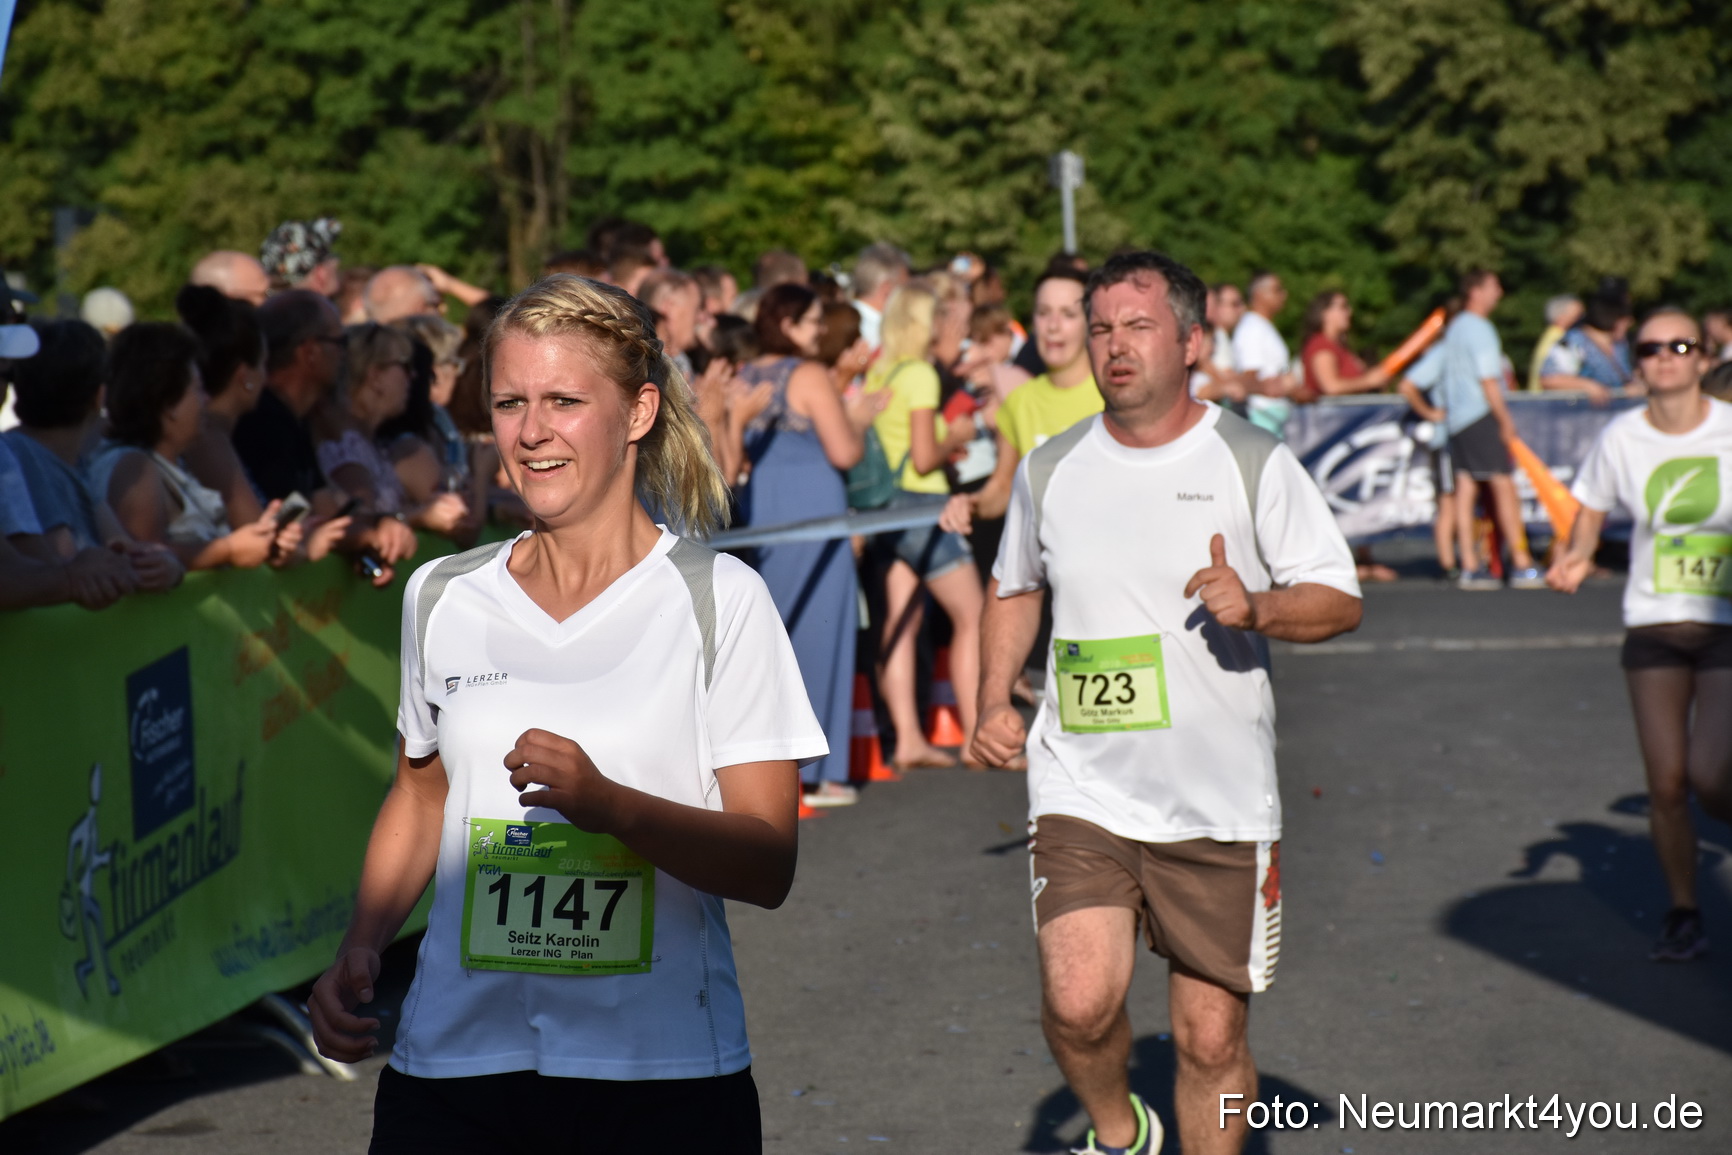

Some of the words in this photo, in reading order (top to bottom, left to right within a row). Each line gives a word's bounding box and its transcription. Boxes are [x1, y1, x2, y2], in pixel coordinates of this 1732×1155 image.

[1177, 492, 1214, 502] Markus
[1676, 557, 1722, 578] 147
[467, 673, 508, 683] LERZER
[1072, 672, 1136, 706] 723
[1101, 707, 1134, 717] Markus
[492, 842, 554, 858] firmenlauf
[558, 858, 592, 870] 2018
[487, 873, 629, 931] 1147
[507, 931, 541, 945] Seitz
[546, 933, 600, 948] Karolin
[510, 946, 541, 957] Lerzer
[543, 949, 562, 959] ING
[570, 950, 594, 960] Plan
